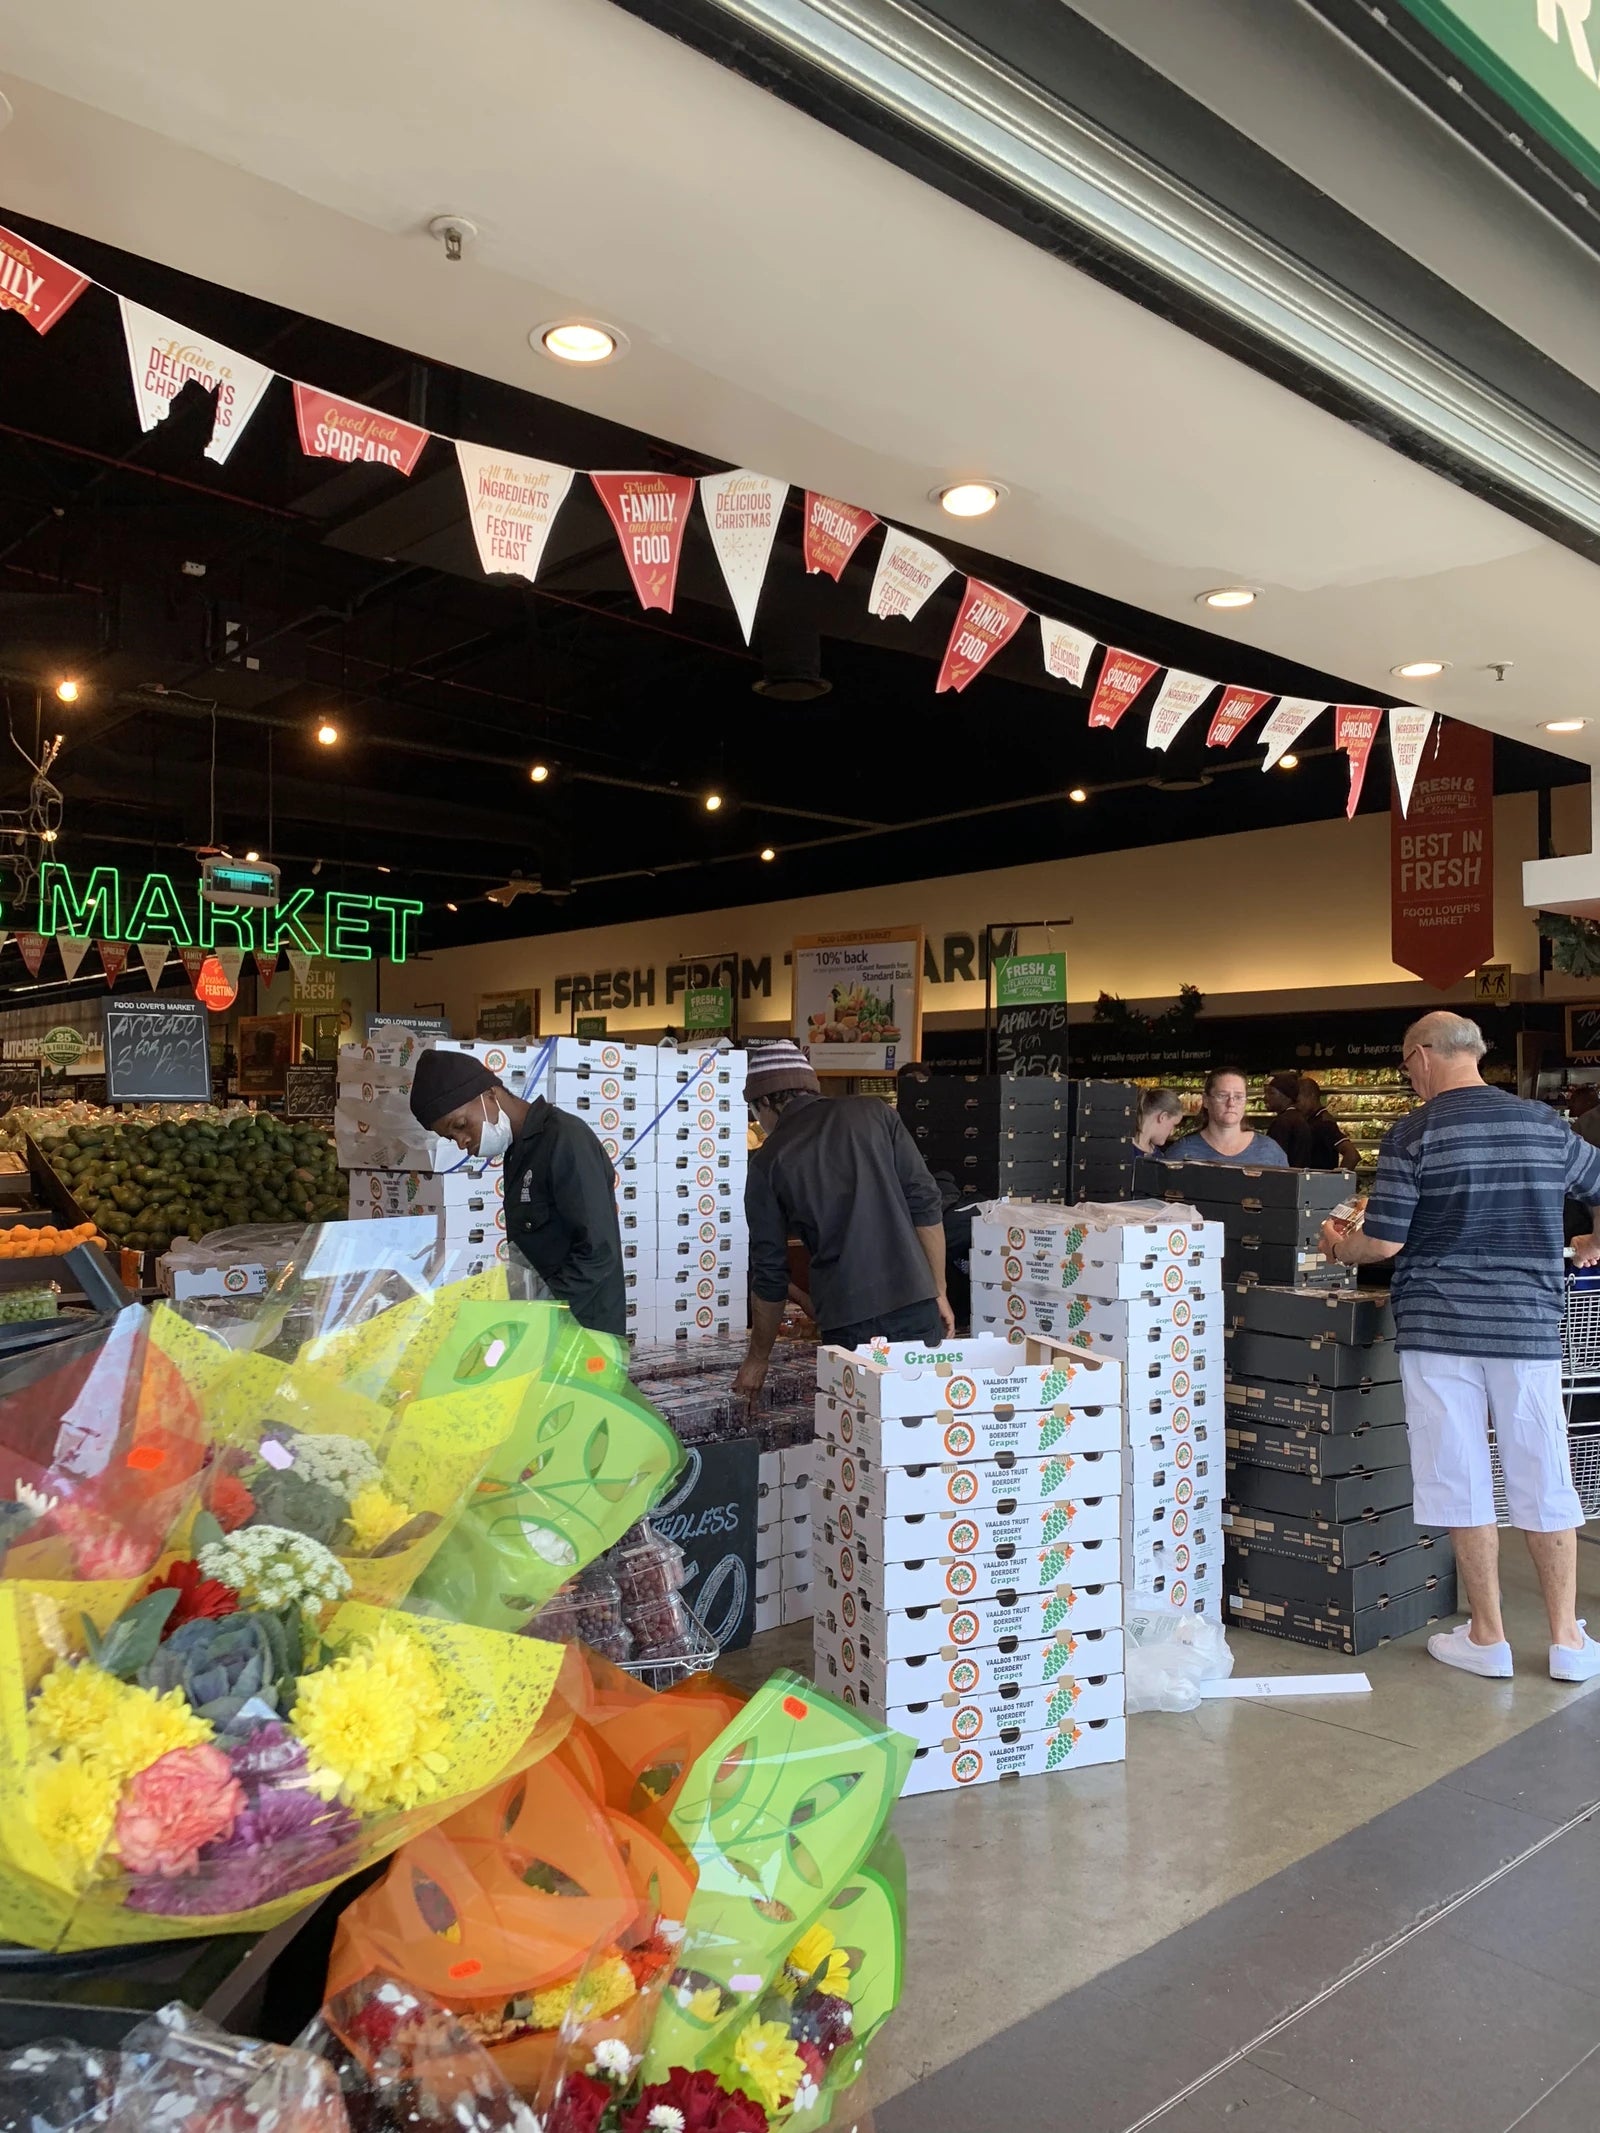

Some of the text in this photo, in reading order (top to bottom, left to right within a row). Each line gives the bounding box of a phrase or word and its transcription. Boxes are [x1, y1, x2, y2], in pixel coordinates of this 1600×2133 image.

[158, 337, 232, 379] Have a
[324, 408, 397, 441] Good food
[479, 464, 552, 489] All the right
[479, 477, 549, 508] INGREDIENTS
[721, 477, 769, 496] Have a
[619, 493, 677, 523] FAMILY,
[716, 493, 771, 512] DELICIOUS
[474, 496, 548, 523] for a fabulous
[715, 513, 771, 530] CHRISTMAS
[811, 501, 857, 547] SPREADS
[486, 514, 533, 543] FESTIVE
[628, 521, 673, 536] and good
[491, 537, 527, 562] FEAST
[633, 535, 670, 565] FOOD
[887, 553, 932, 589] INGREDIENTS
[880, 582, 912, 612] FESTIVE
[965, 599, 1010, 640] FAMILY,
[952, 631, 988, 664] FOOD
[1050, 642, 1081, 669] DELICIOUS
[1103, 667, 1142, 694] SPREADS
[1156, 707, 1182, 723] FESTIVE
[1154, 720, 1174, 735] FEAST
[1210, 723, 1236, 742] FOOD
[1340, 721, 1372, 738] SPREADS
[1397, 743, 1418, 755] FESTIVE
[1399, 754, 1415, 766] FEAST
[1411, 777, 1475, 797] FRESH &
[1415, 793, 1470, 807] FLAVOURFUL
[1400, 829, 1482, 860] BEST IN
[1400, 857, 1482, 892] FRESH
[39, 862, 423, 963] MARKET
[1403, 903, 1480, 918] FOOD LOVER'S
[1419, 915, 1465, 927] MARKET
[817, 936, 835, 944] FOOD
[844, 949, 869, 964] back
[325, 970, 336, 983] IN
[862, 970, 894, 982] Standard
[1006, 963, 1056, 979] FRESH &
[1009, 977, 1051, 989] FLAVOURFUL
[294, 983, 335, 1000] FRESH
[554, 967, 656, 1014] FRESH
[113, 1001, 196, 1011] FOOD LOVER'S MARKET
[691, 995, 724, 1007] FRESH &
[374, 1017, 441, 1028] FOOD LOVER'S MARKET
[998, 1004, 1066, 1034] APRICOTS
[112, 1015, 198, 1039] AVOCADO
[56, 1033, 72, 1042] 25
[134, 1038, 160, 1059] FOR
[997, 1039, 1017, 1060] 3
[1347, 1043, 1361, 1055] Our
[1364, 1043, 1390, 1056] buyers
[1103, 1052, 1125, 1063] proudly
[1126, 1051, 1149, 1062] support
[1150, 1052, 1161, 1060] our
[1163, 1050, 1179, 1060] local
[1181, 1049, 1211, 1059] farmers!
[904, 1351, 964, 1365] Grapes
[982, 1378, 1008, 1386] VAALBOS
[990, 1386, 1020, 1394] BOERDERY
[990, 1393, 1021, 1402] Grapes
[981, 1423, 1007, 1431] VAALBOS
[1191, 1418, 1207, 1426] Grapes
[989, 1431, 1019, 1439] BOERDERY
[989, 1439, 1019, 1447] Grapes
[984, 1470, 1009, 1478] VAALBOS
[992, 1478, 1021, 1486] BOERDERY
[992, 1486, 1021, 1494] Grapes
[985, 1520, 1010, 1528] VAALBOS
[992, 1527, 1022, 1536] BOERDERY
[992, 1535, 1022, 1543] Grapes
[983, 1558, 1028, 1569] VAALBOS TRUST
[991, 1568, 1020, 1576] BOERDERY
[990, 1576, 1020, 1584] Grapes
[986, 1606, 1030, 1618] VAALBOS TRUST
[993, 1616, 1022, 1625] BOERDERY
[993, 1624, 1022, 1633] Grapes
[986, 1654, 1031, 1666] VAALBOS TRUST
[993, 1664, 1023, 1673] BOERDERY
[993, 1672, 1023, 1681] Grapes
[989, 1701, 1034, 1713] VAALBOS TRUST
[996, 1711, 1026, 1720] BOERDERY
[996, 1719, 1026, 1728] Grapes
[989, 1744, 1034, 1756] VAALBOS TRUST
[996, 1754, 1026, 1764] BOERDERY
[996, 1761, 1026, 1770] Grapes
